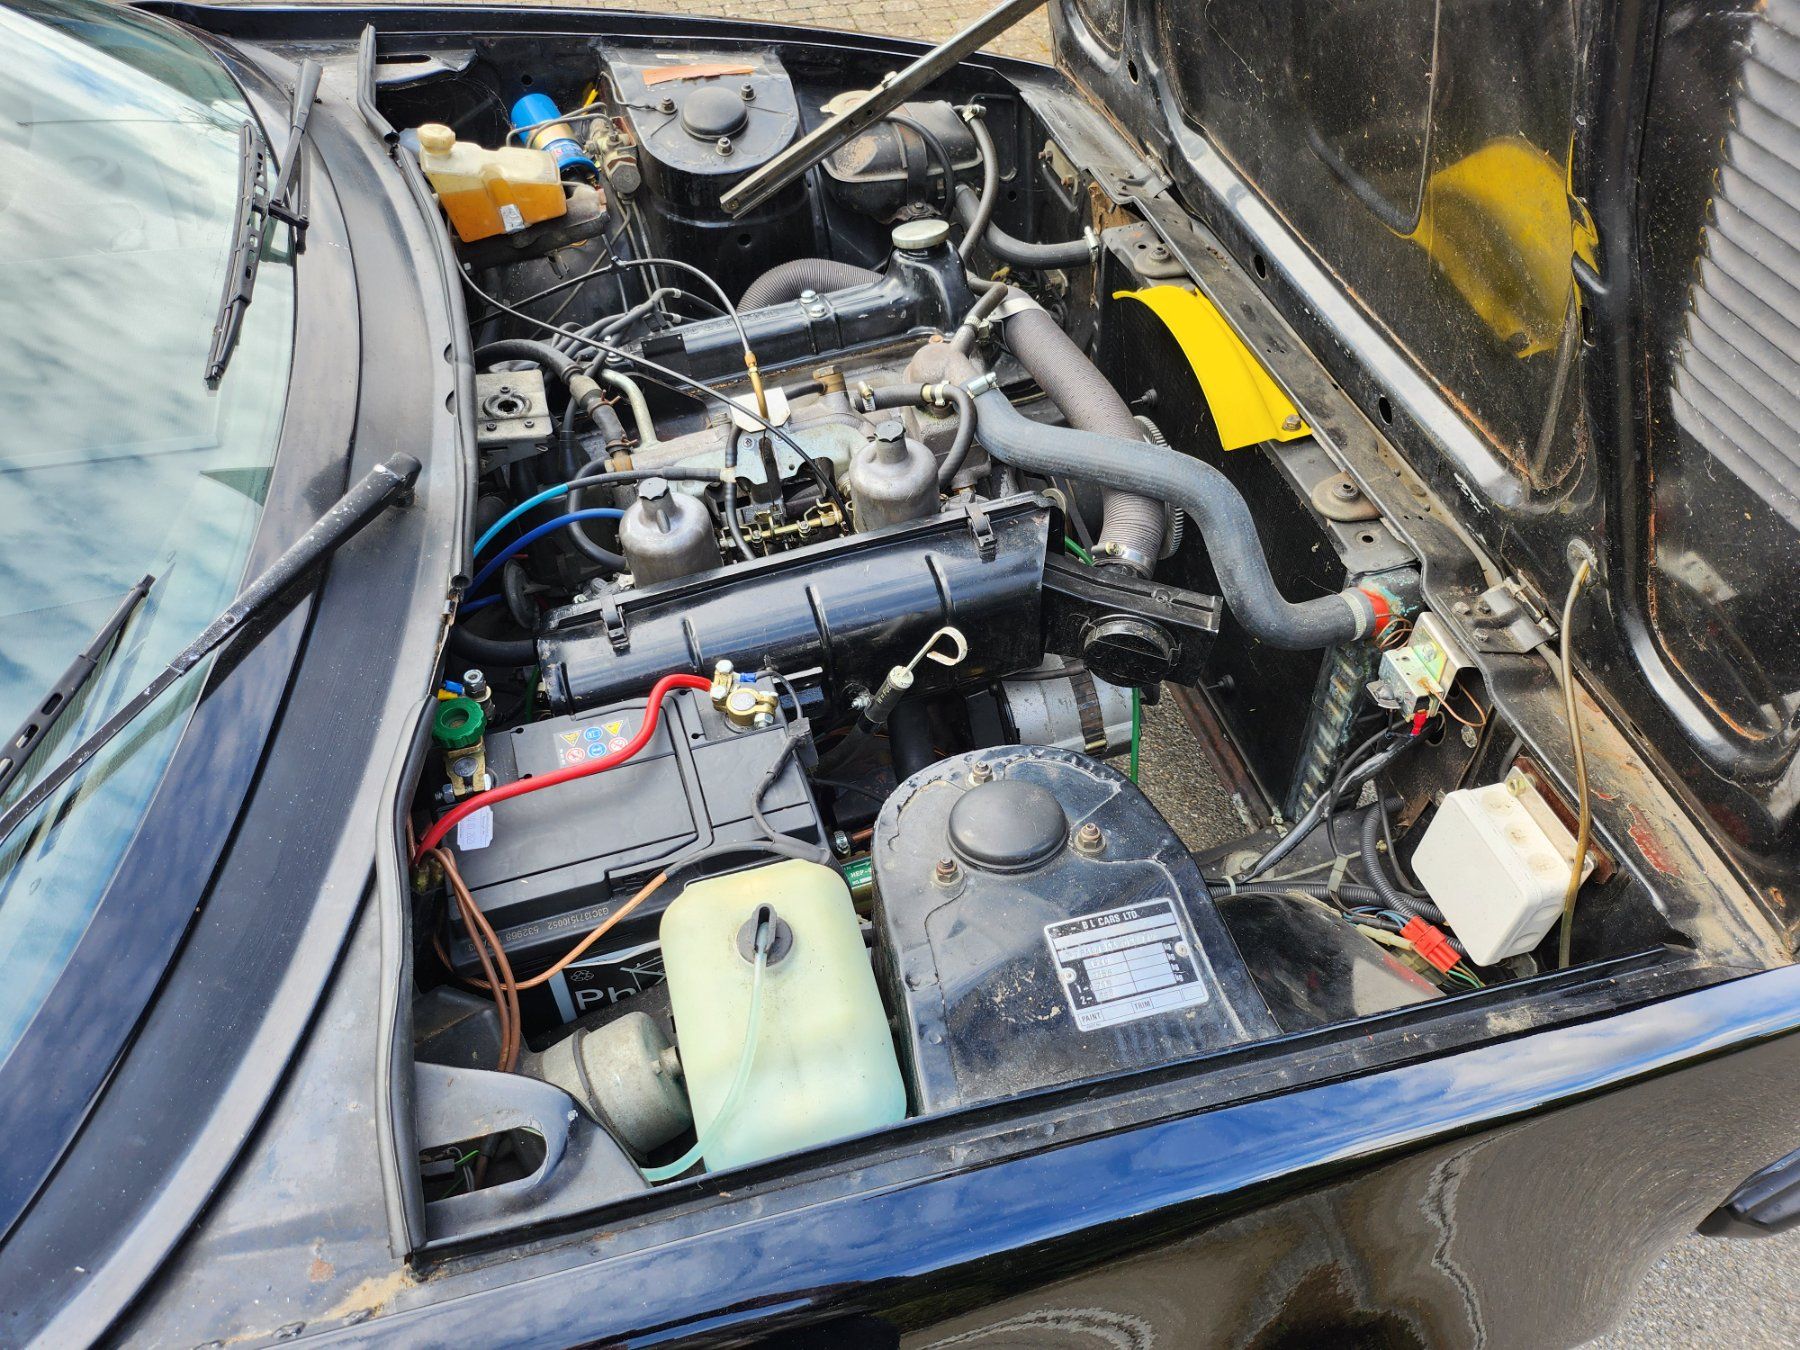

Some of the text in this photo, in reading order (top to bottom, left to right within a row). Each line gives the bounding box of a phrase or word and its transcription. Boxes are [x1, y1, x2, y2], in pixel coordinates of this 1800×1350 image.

[1081, 921, 1088, 930] B
[1090, 919, 1096, 928] L
[1097, 913, 1121, 926] CARS
[1133, 1000, 1151, 1010] TRIM
[1081, 1011, 1101, 1022] PAINT
